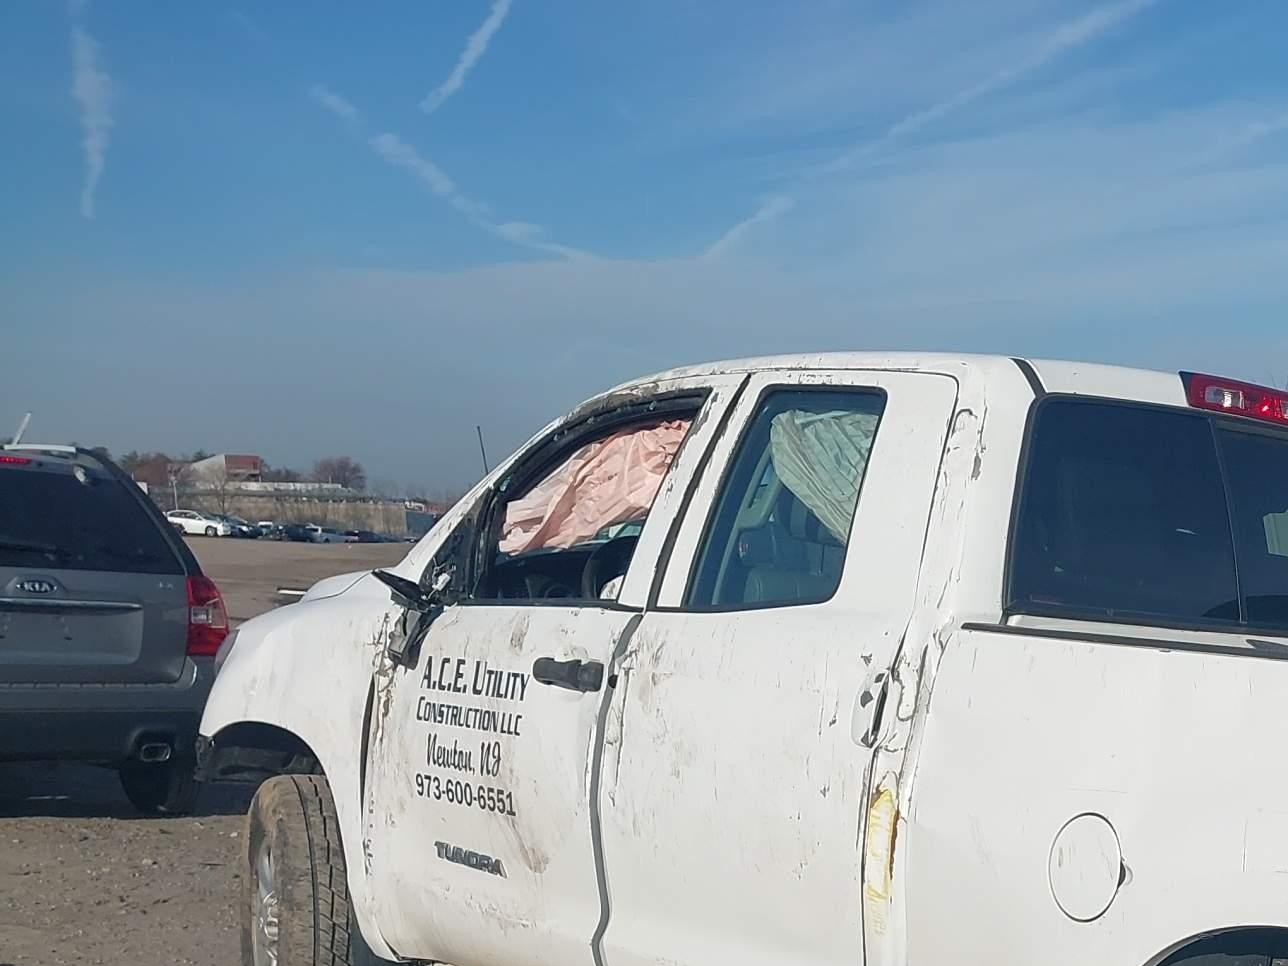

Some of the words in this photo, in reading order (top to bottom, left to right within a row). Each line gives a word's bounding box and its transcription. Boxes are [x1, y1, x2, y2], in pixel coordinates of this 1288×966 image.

[23, 581, 51, 592] KIA
[420, 655, 467, 695] A.C.E.
[472, 660, 531, 701] UTILITY
[416, 696, 499, 733] CONSTRUCTION
[500, 714, 523, 736] LLC
[426, 733, 476, 776] Newton,
[480, 740, 502, 777] NJ
[415, 773, 517, 817] 973-600-6551
[434, 841, 508, 879] TUNDRA
